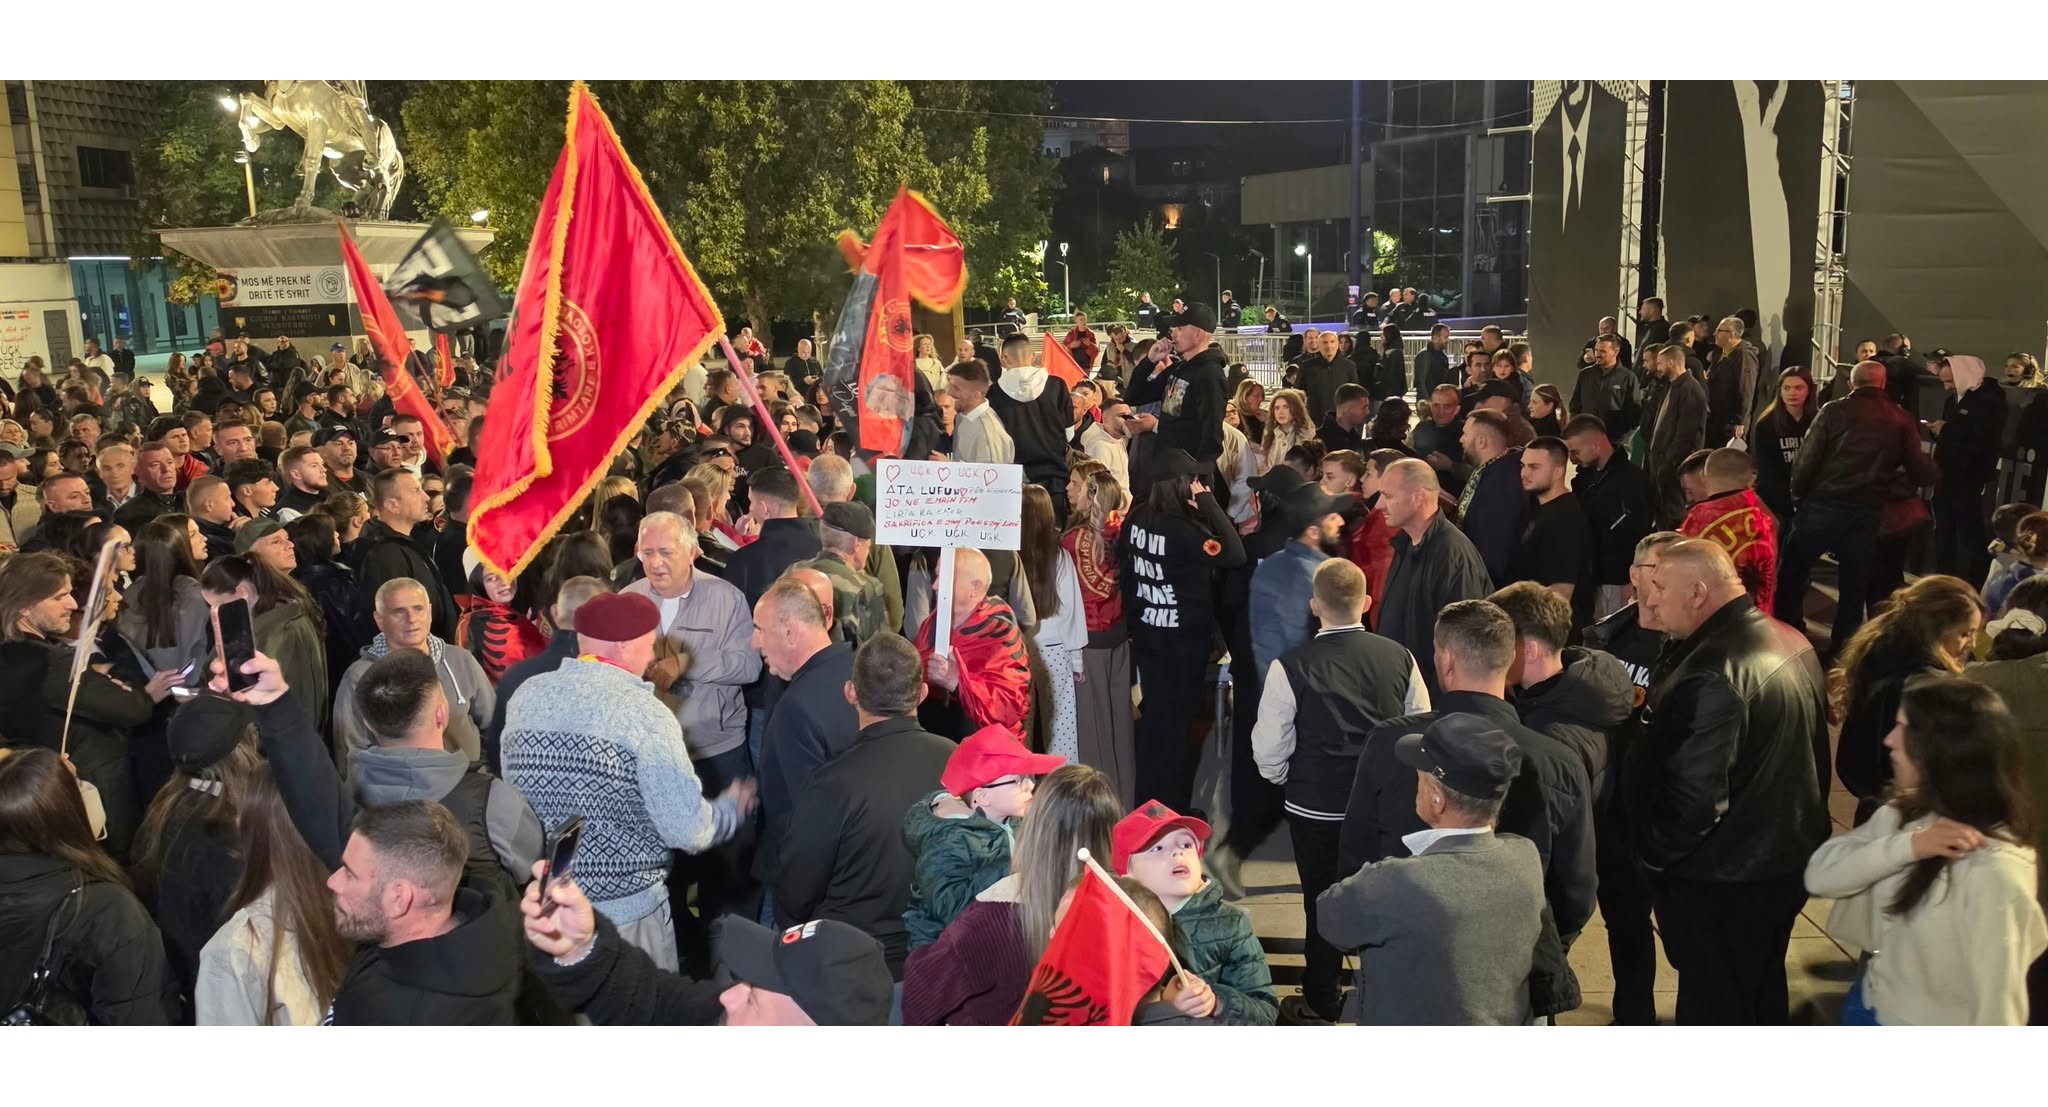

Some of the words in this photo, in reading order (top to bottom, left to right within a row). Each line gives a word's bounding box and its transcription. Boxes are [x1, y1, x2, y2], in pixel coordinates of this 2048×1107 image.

[241, 277, 260, 287] MOS
[261, 275, 274, 286] MË
[275, 276, 298, 286] PREK
[300, 274, 312, 285] NË
[248, 289, 273, 300] DRITË
[274, 288, 285, 299] TË
[286, 289, 310, 299] SYRIT
[564, 311, 596, 356] KOSOV
[586, 361, 597, 370] E
[554, 375, 596, 432] RIMTARE
[886, 484, 914, 495] ATA
[885, 498, 900, 508] JO
[1130, 524, 1147, 550] PO
[1148, 533, 1166, 556] VI
